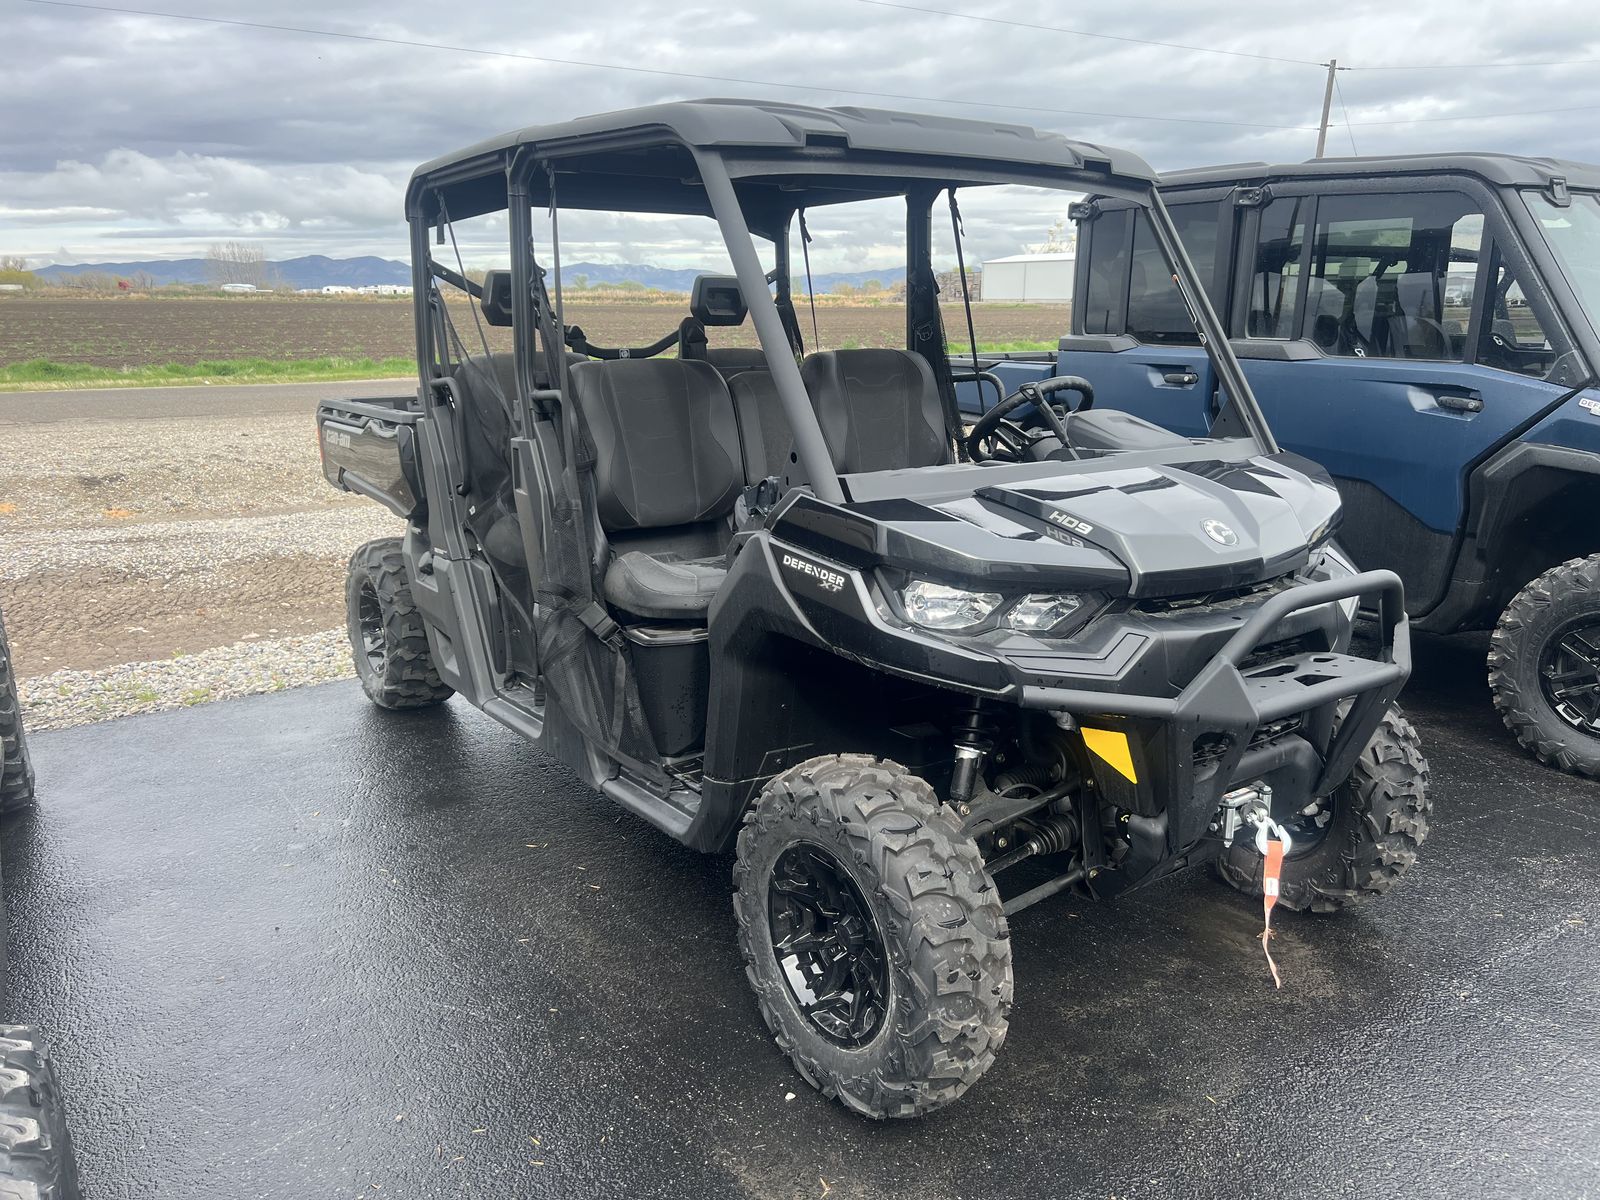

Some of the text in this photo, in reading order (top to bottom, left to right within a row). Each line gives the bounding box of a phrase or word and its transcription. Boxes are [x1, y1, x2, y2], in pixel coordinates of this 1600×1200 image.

[1580, 399, 1600, 409] DEF
[1049, 510, 1094, 535] HD9
[783, 554, 845, 587] DEFENDER
[818, 580, 843, 592] XT
